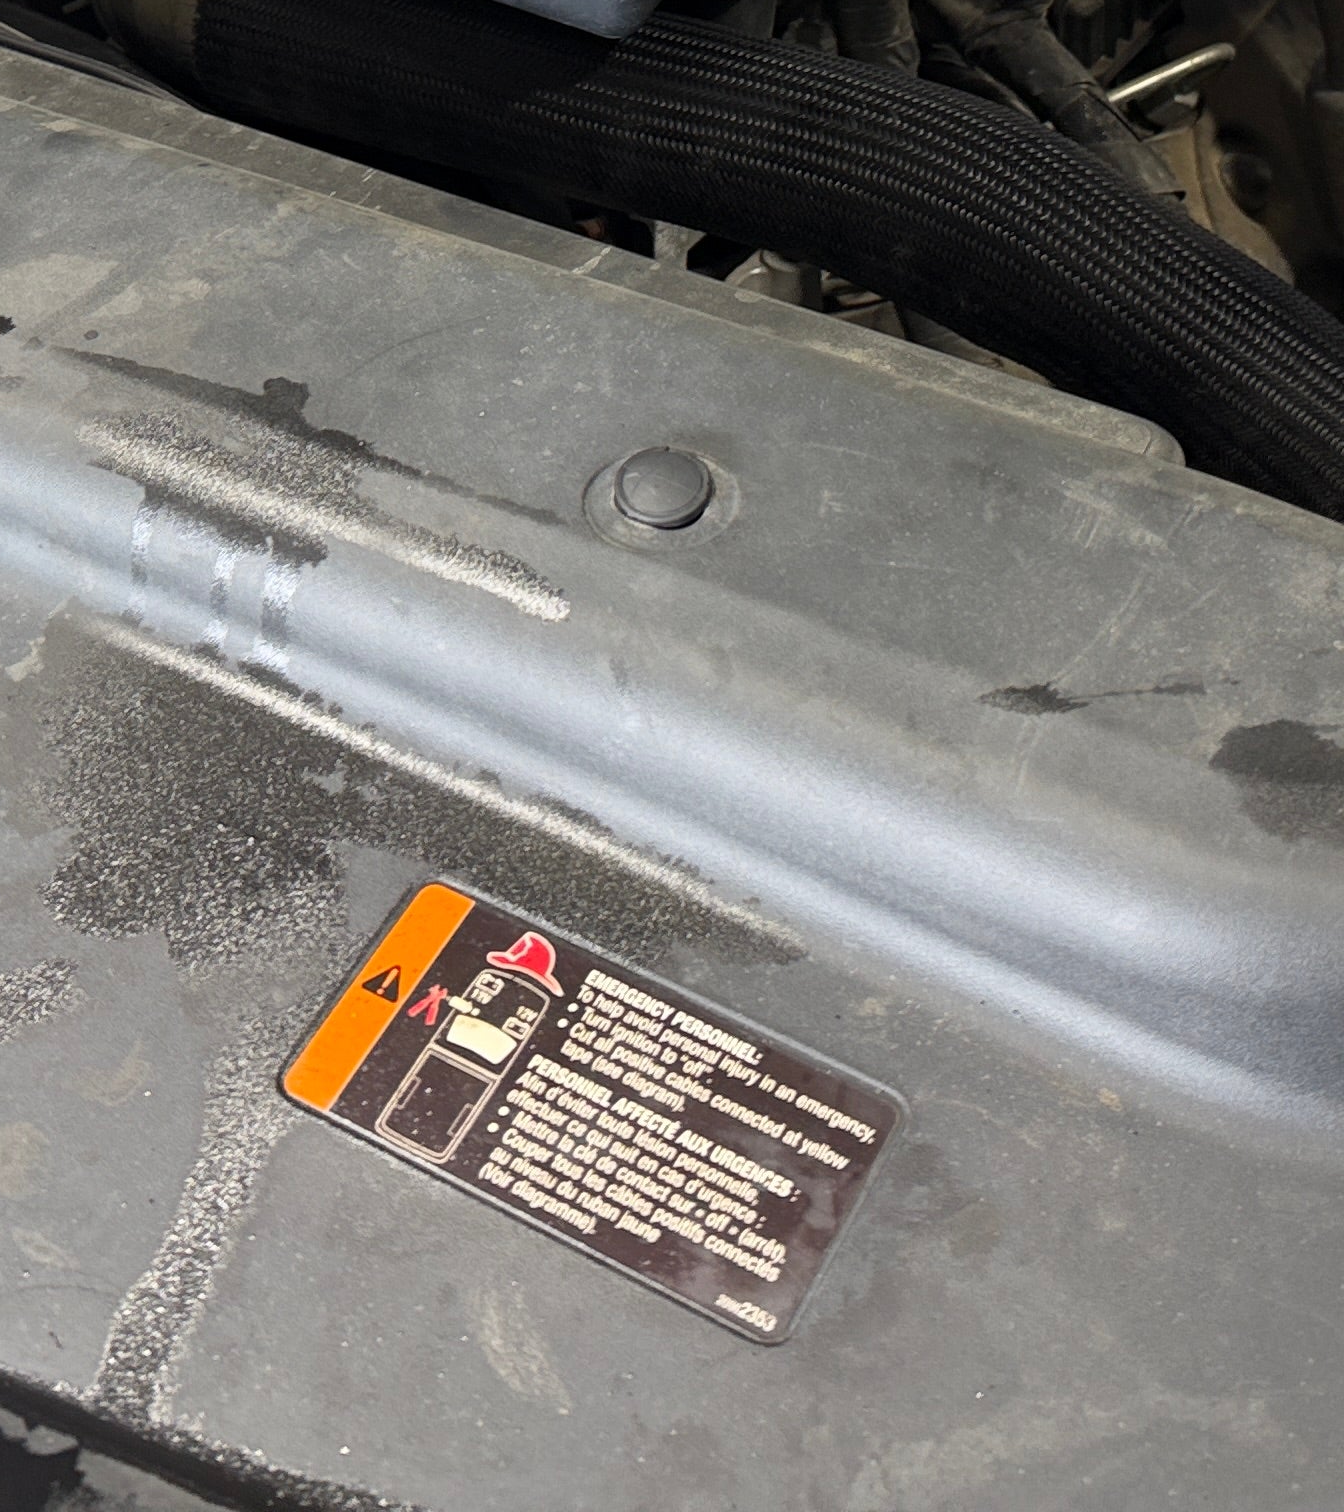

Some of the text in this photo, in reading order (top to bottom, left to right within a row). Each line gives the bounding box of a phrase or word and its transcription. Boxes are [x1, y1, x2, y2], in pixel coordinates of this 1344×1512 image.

[560, 1038, 685, 1112] tape (see diagram).
[576, 984, 876, 1145] To help avoid personal injury in an emergency,
[580, 1006, 613, 1032] Turn
[609, 1021, 663, 1057] ignition
[659, 1046, 678, 1065] to
[584, 969, 763, 1066] EMERGENCY PERSONNEL:
[506, 1088, 570, 1127] effectuer
[566, 1119, 588, 1138] ce
[585, 1129, 613, 1152] qui
[608, 1141, 641, 1164] suit
[636, 1155, 659, 1174] en
[657, 1165, 686, 1188] cas
[515, 1070, 547, 1095] Afin
[596, 1110, 635, 1140] toute
[632, 1128, 677, 1161] lésion
[672, 1152, 759, 1206] personnelle,
[526, 1053, 613, 1108] PERSONNEL
[610, 1097, 681, 1141] AFFECTÉ
[674, 1129, 714, 1157] AUX
[709, 1144, 795, 1198] URGENCES
[569, 1022, 850, 1170] Cut all positive cables connected at yellow
[478, 1161, 597, 1235] (Voir diagramme).
[489, 1146, 661, 1243] au niveau du ruban jaune
[501, 1127, 781, 1283] Couper tous les câbles positifs connectés
[511, 1110, 560, 1145] Mettre
[556, 1133, 575, 1154] la
[572, 1142, 599, 1165] clé
[595, 1155, 618, 1175] de
[615, 1166, 672, 1203] contact
[667, 1193, 697, 1214] sur
[737, 1227, 787, 1265] (arrêt).
